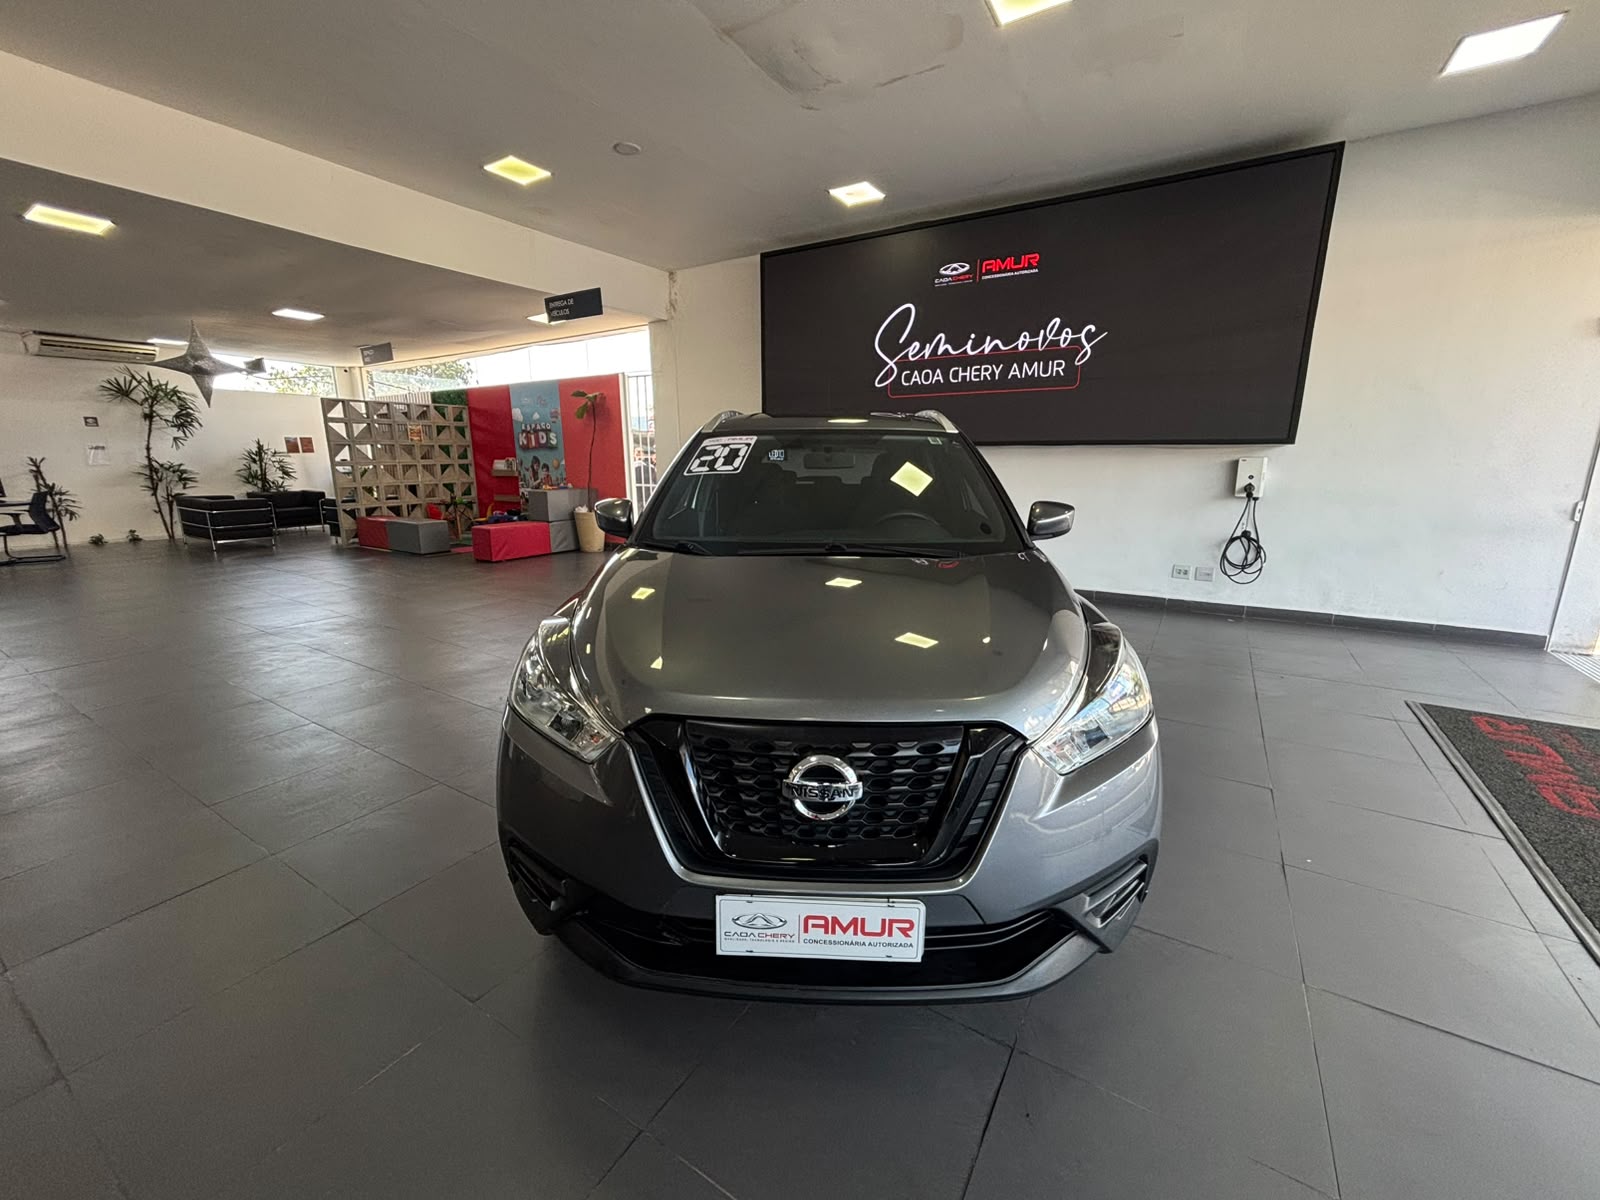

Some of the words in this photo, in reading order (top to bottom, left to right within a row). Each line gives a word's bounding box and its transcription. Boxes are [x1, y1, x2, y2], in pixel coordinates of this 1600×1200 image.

[982, 253, 1040, 273] AMUR
[874, 303, 1108, 387] Seminovos
[901, 368, 944, 386] CAOA
[949, 364, 1003, 383] CHERY
[1008, 359, 1065, 380] AMUR
[689, 444, 749, 472] 20
[791, 785, 859, 798] NISSAN
[803, 914, 915, 938] AMUR
[803, 938, 866, 947] CONCESSIONÁRIA
[867, 941, 914, 949] AUTORIZADA
